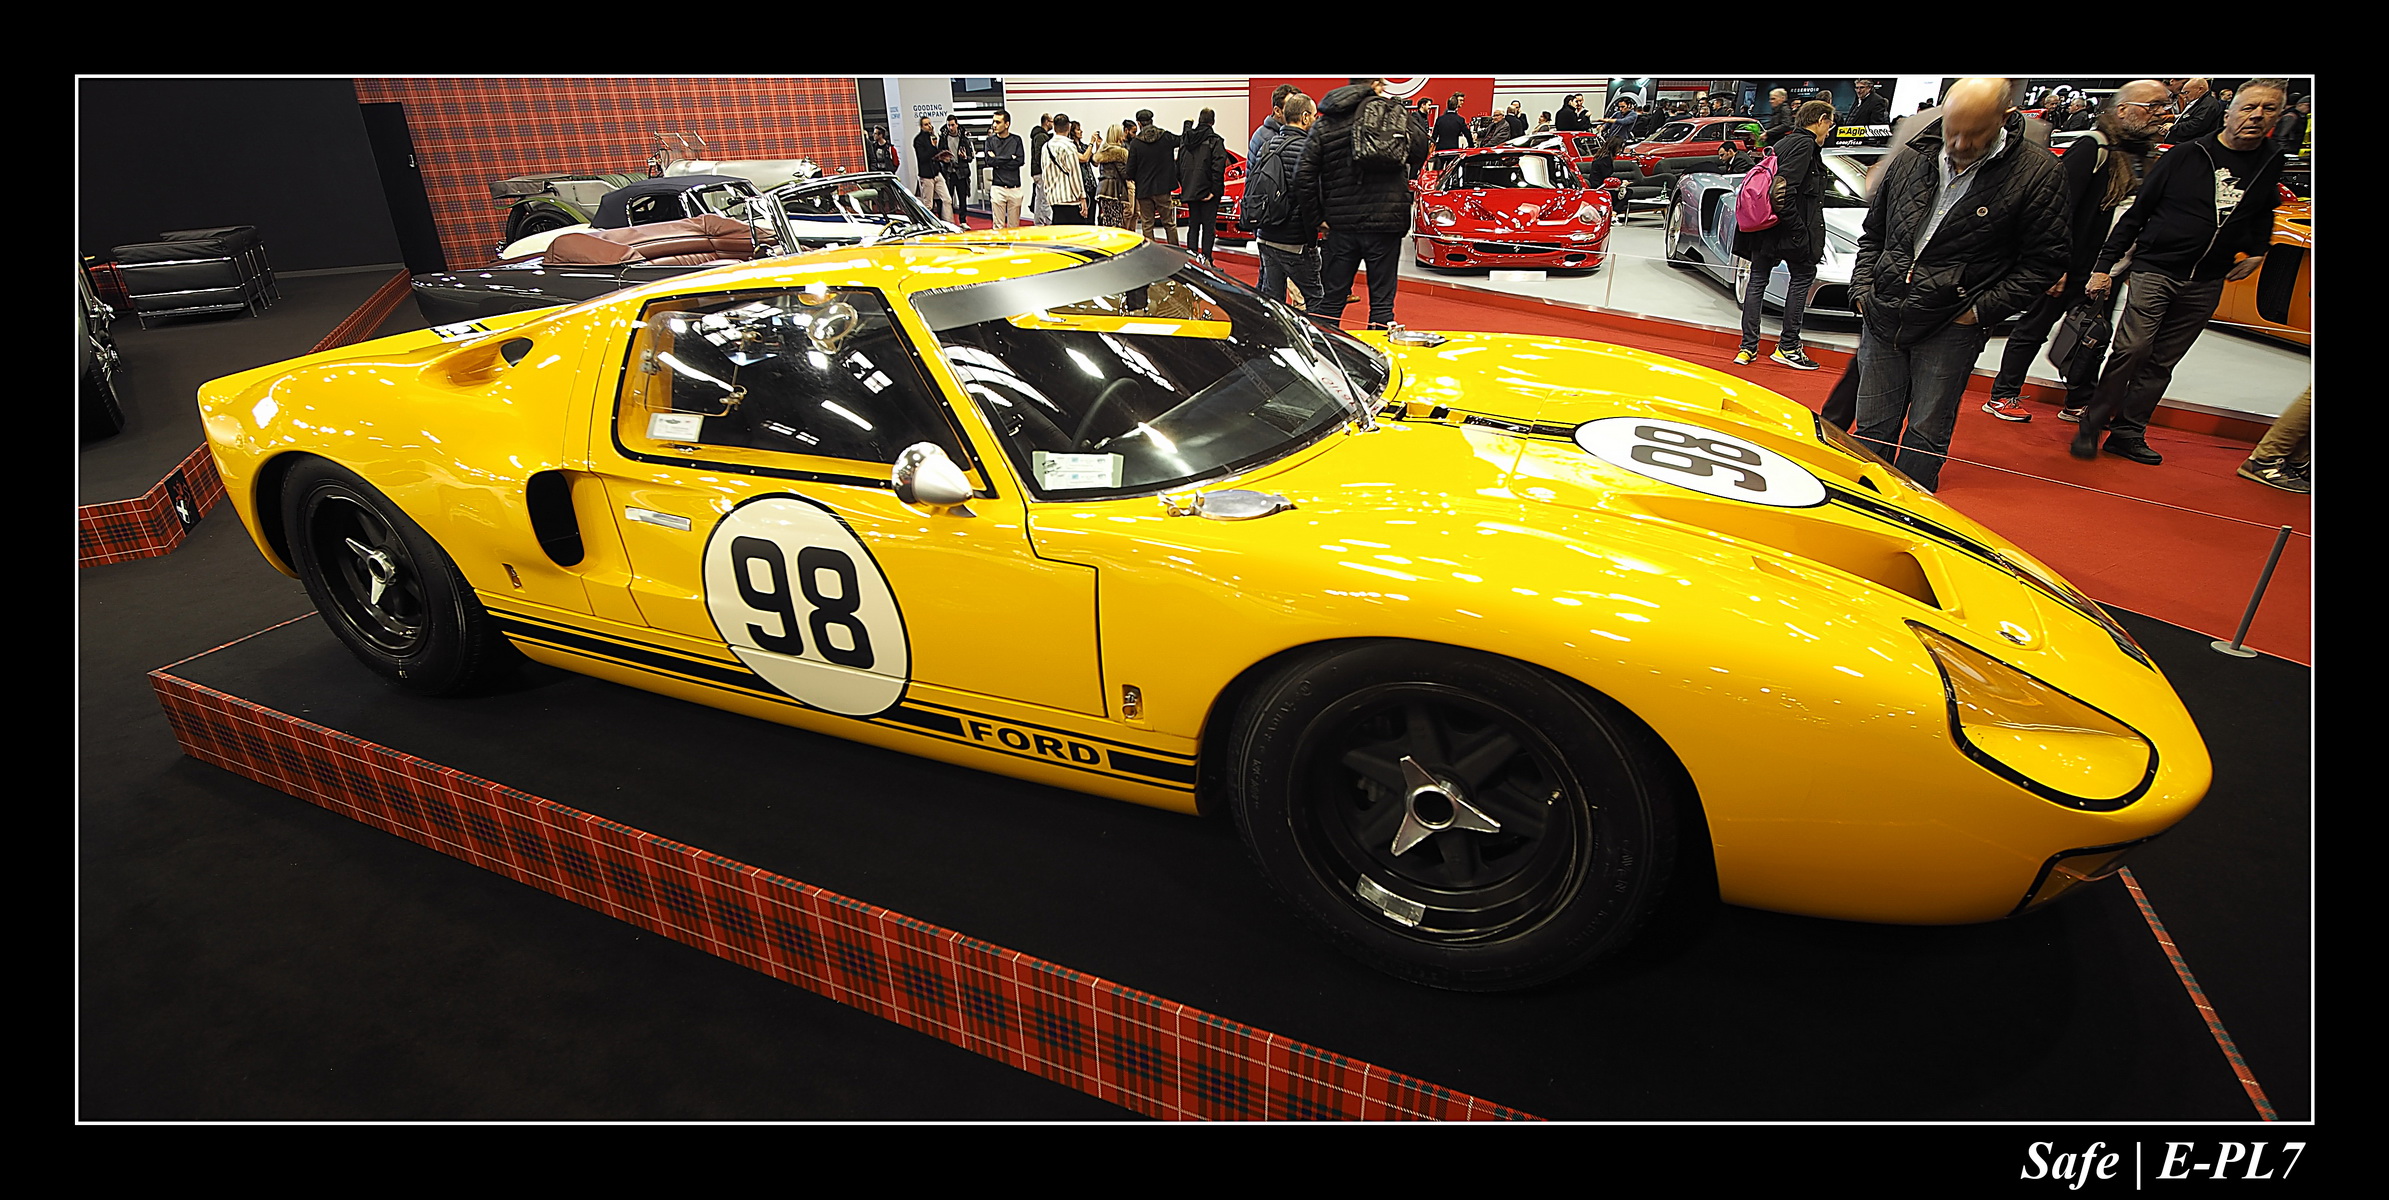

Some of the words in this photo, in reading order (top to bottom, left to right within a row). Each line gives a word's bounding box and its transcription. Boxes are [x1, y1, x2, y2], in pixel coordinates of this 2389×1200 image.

[912, 104, 943, 112] GOODING
[913, 110, 948, 119] &COMPANY
[1846, 127, 1865, 137] Agip
[1630, 425, 1767, 492] 98
[730, 535, 875, 670] 98
[967, 719, 1101, 765] FORD
